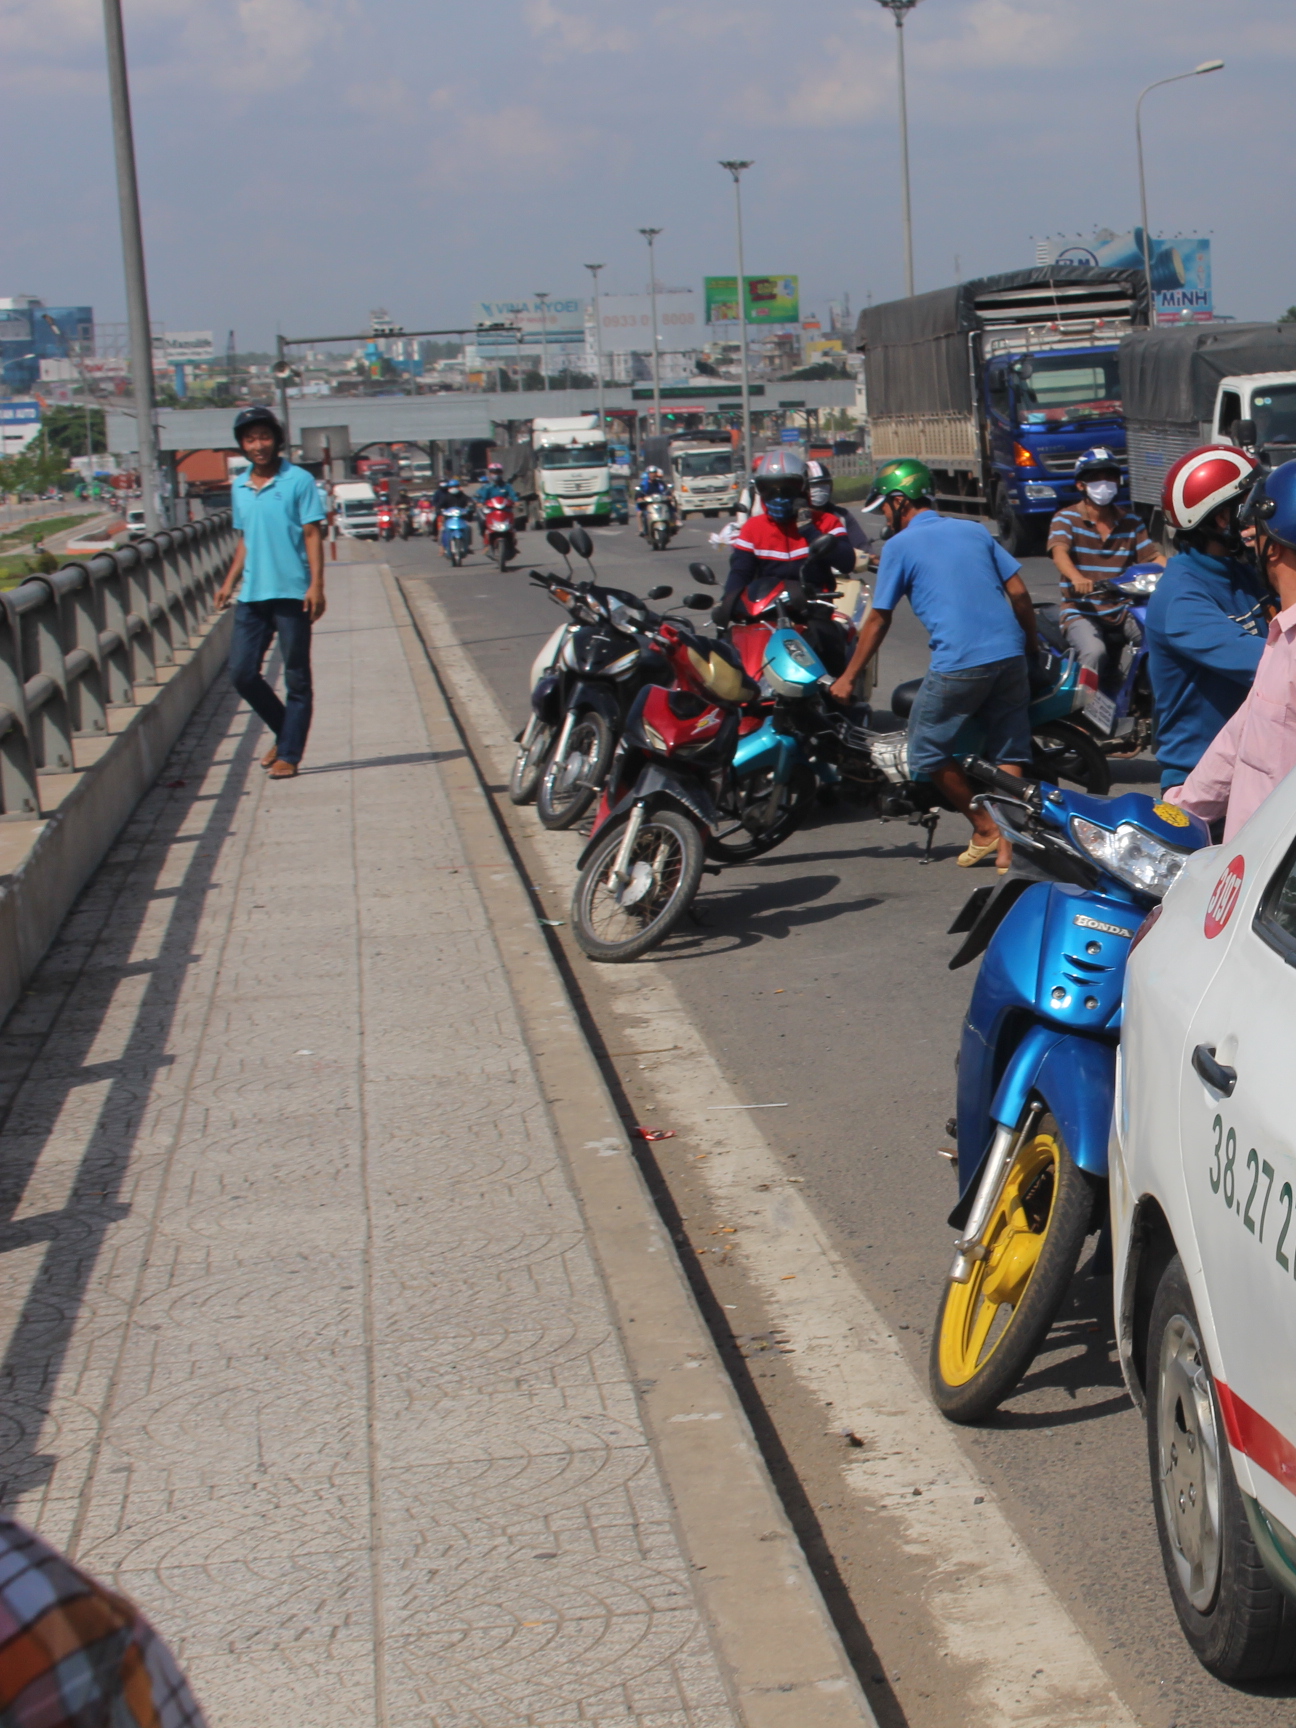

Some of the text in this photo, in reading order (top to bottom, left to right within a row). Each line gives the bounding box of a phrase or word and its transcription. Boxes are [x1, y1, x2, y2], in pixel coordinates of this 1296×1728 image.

[496, 300, 579, 314] VINA KYOEI
[602, 314, 638, 328] 0933
[1207, 867, 1242, 925] 3197
[1074, 914, 1133, 938] HONDA
